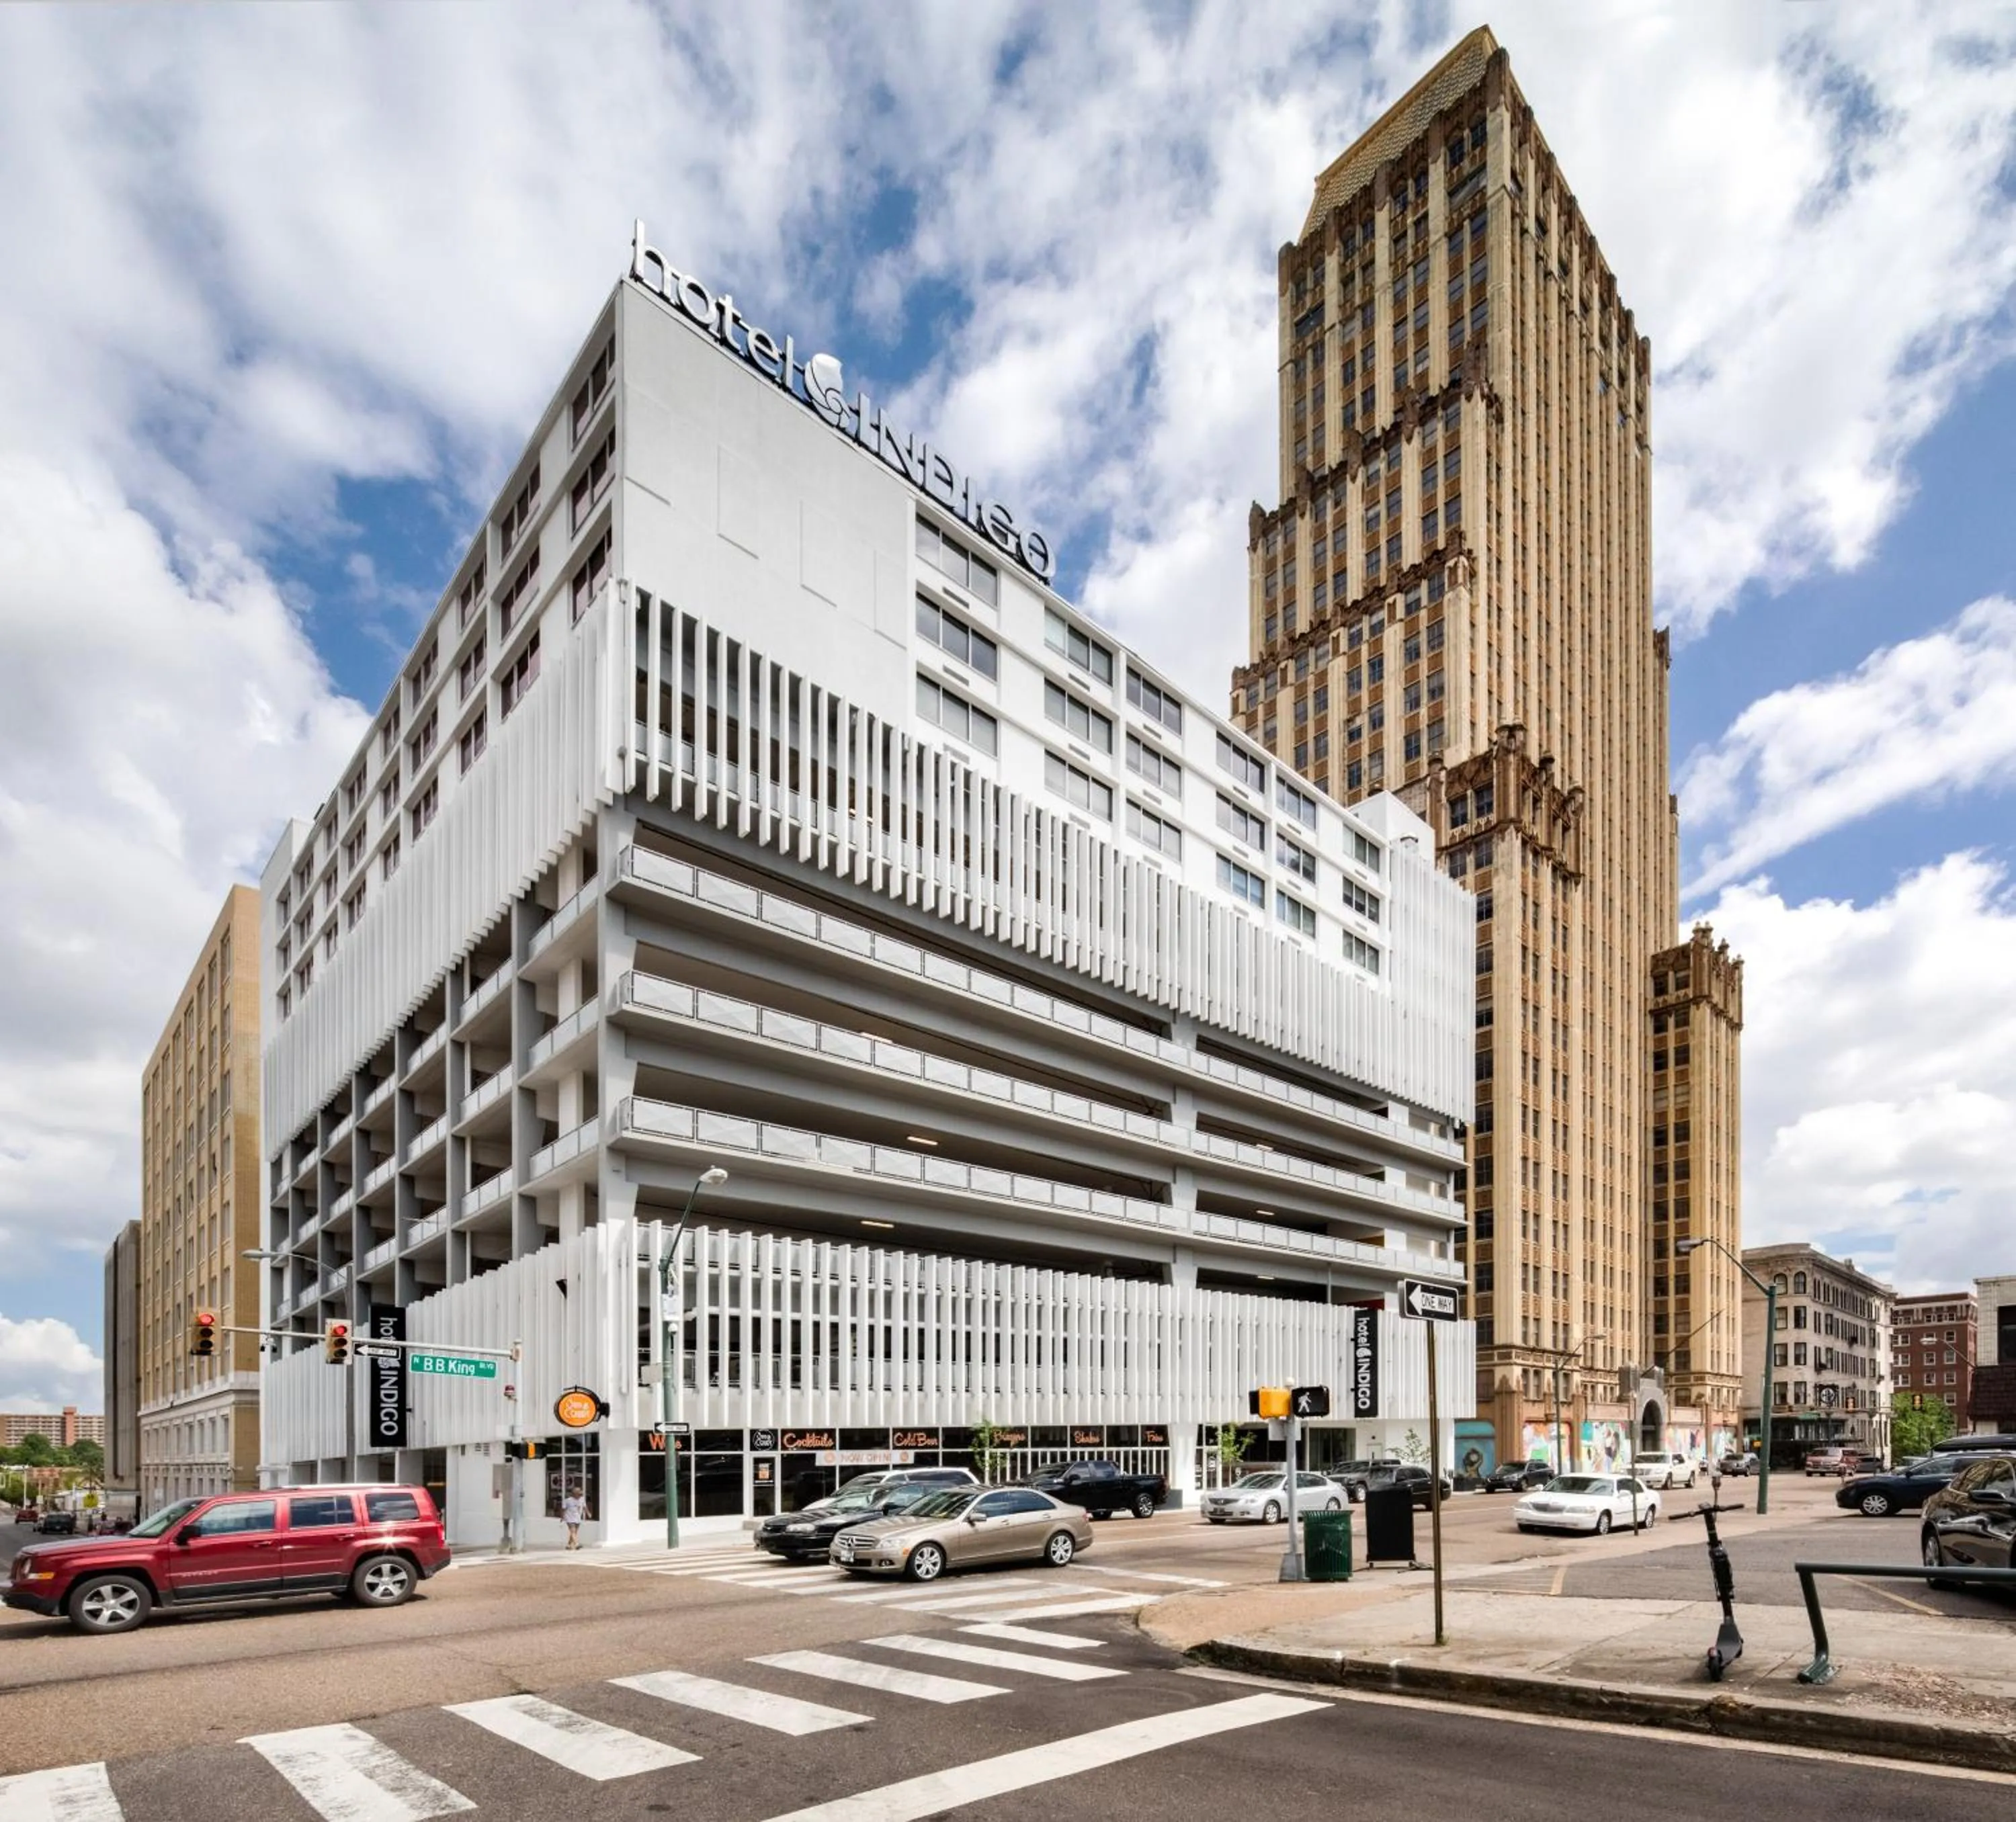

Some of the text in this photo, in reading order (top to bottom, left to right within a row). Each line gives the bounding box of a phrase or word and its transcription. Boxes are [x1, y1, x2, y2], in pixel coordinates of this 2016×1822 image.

[632, 218, 1056, 583] hotel INDIGO
[1421, 1293, 1452, 1312] ONE WAY
[448, 1359, 475, 1375] King
[1357, 1317, 1370, 1409] hotel INDIGO
[380, 1370, 398, 1436] INDIGO
[783, 1432, 834, 1448] Cocktails
[893, 1432, 917, 1446] Cold
